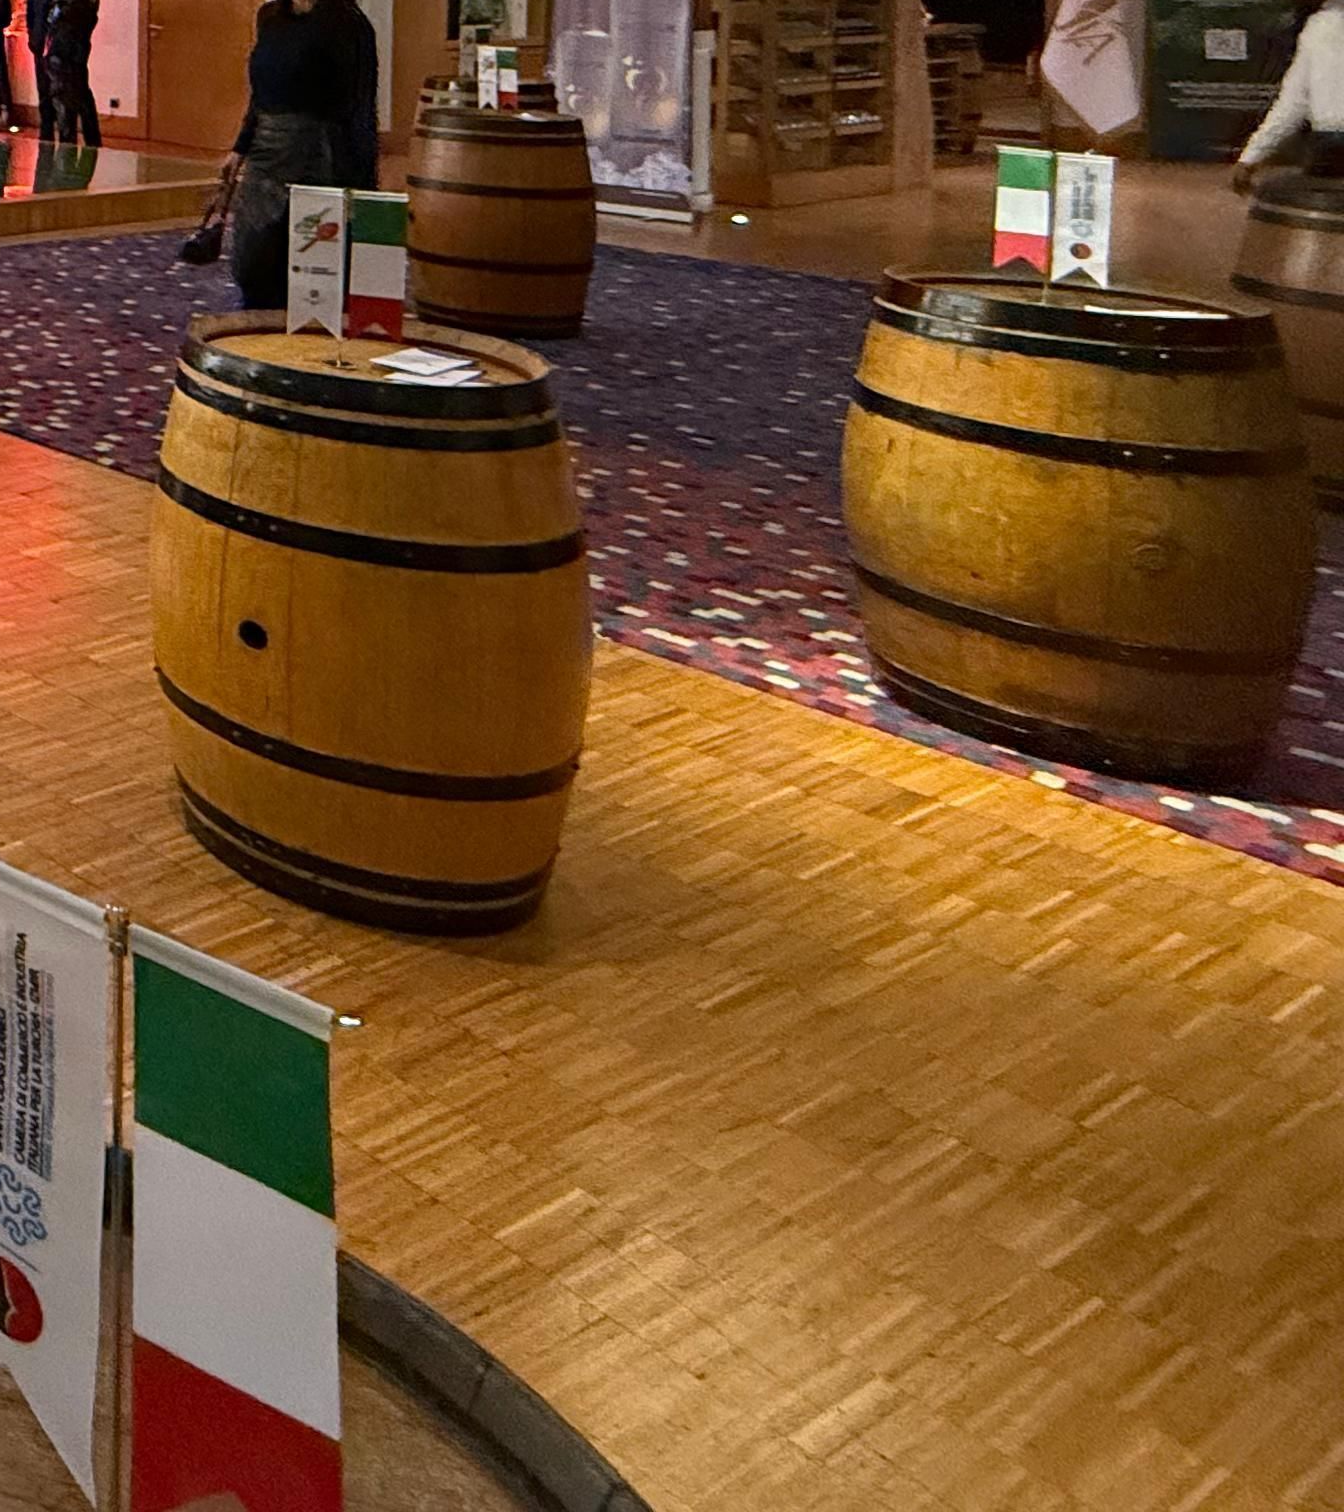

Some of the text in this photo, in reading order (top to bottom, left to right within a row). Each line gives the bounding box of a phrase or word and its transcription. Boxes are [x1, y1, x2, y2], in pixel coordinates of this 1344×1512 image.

[14, 932, 27, 1001] INDUSTRIA
[31, 1067, 43, 1085] LA
[13, 1109, 27, 1165] CAMERA
